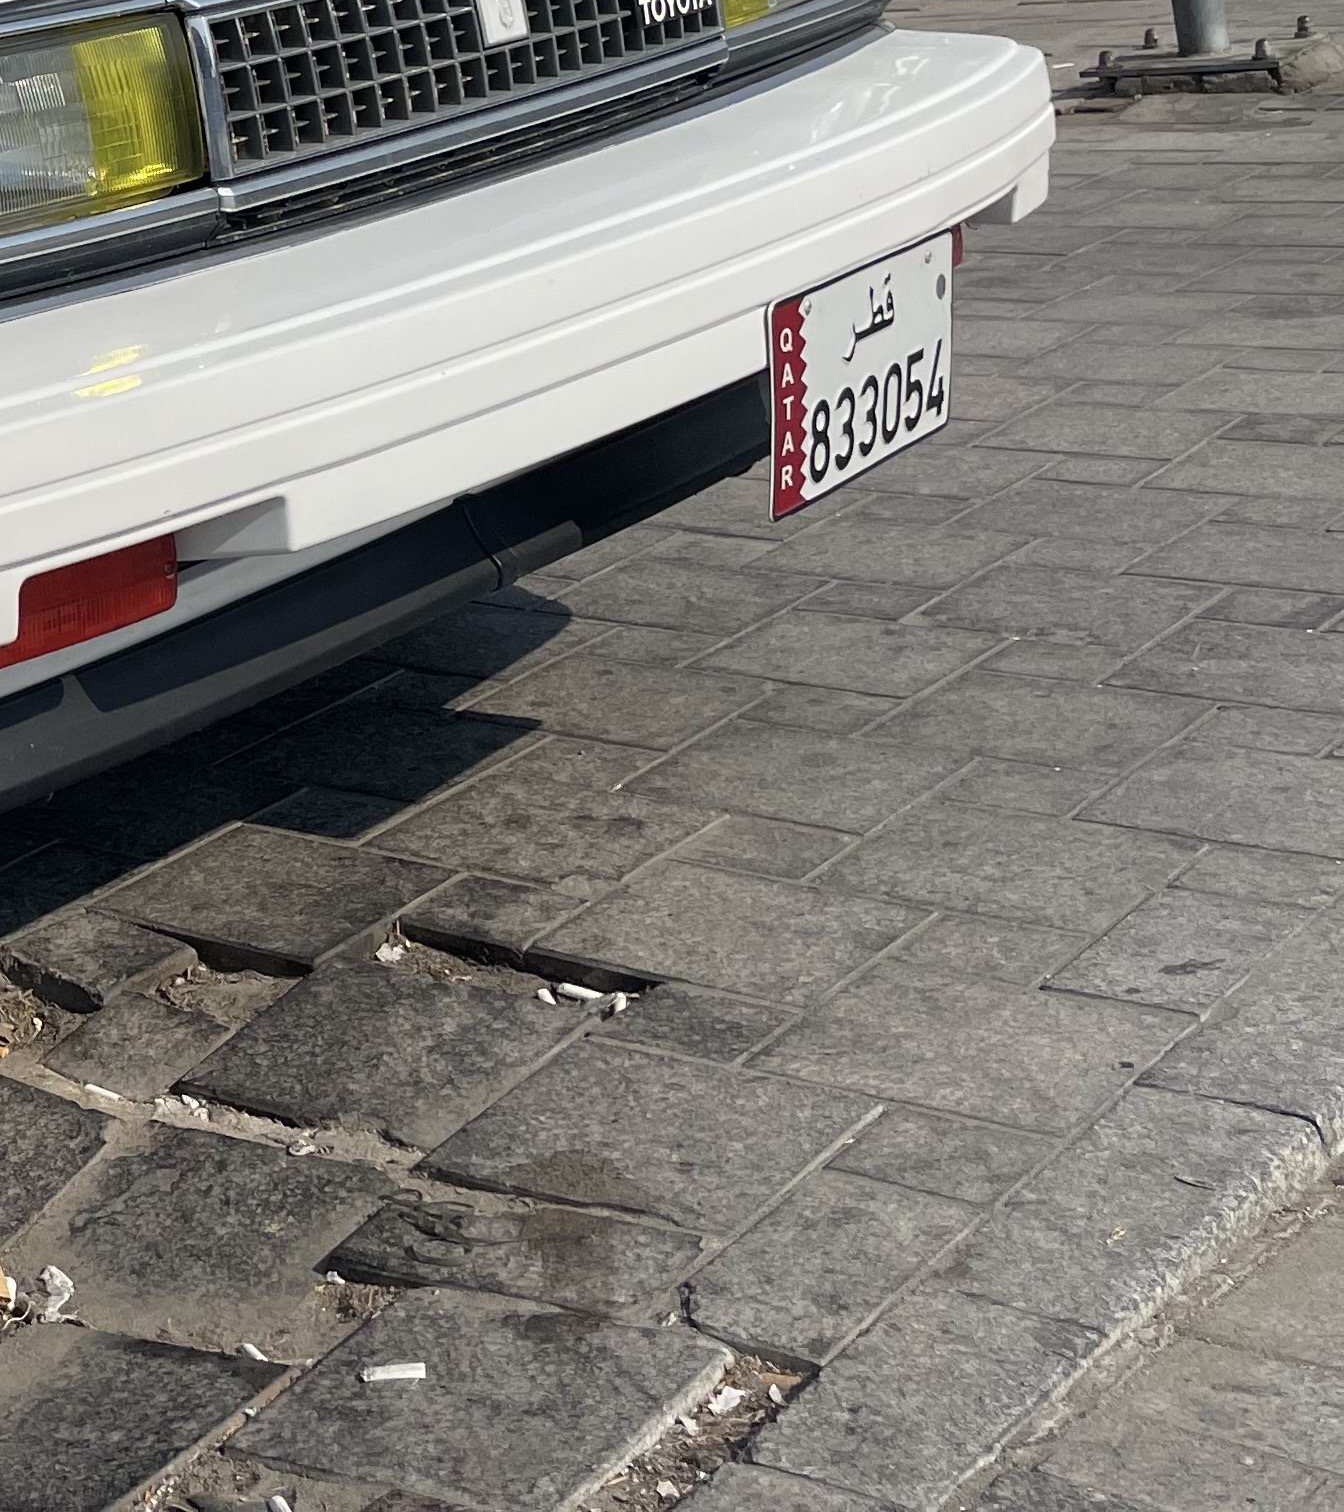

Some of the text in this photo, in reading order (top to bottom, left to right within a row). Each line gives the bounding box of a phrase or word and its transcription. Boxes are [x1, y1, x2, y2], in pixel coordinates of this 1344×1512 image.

[841, 271, 896, 364] قطر
[779, 326, 795, 491] QATAR
[809, 337, 945, 484] 833054
